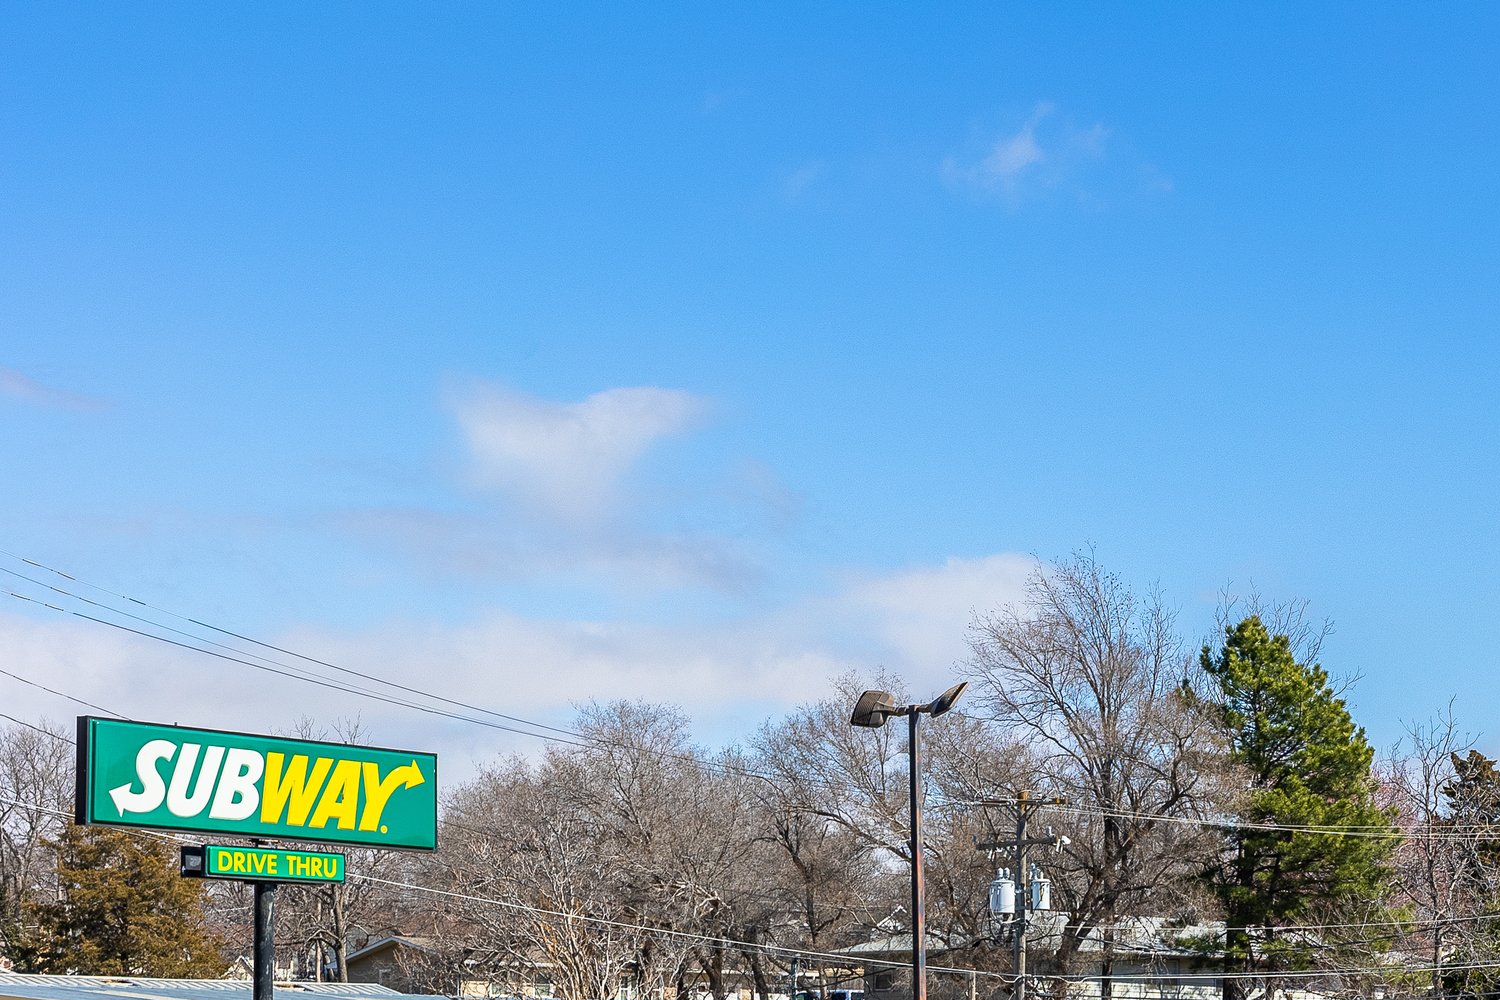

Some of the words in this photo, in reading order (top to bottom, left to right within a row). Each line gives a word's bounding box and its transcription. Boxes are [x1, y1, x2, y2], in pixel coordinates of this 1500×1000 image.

[109, 739, 425, 833] SUBWAY
[217, 851, 278, 875] DRIVE
[286, 855, 338, 879] THRU
